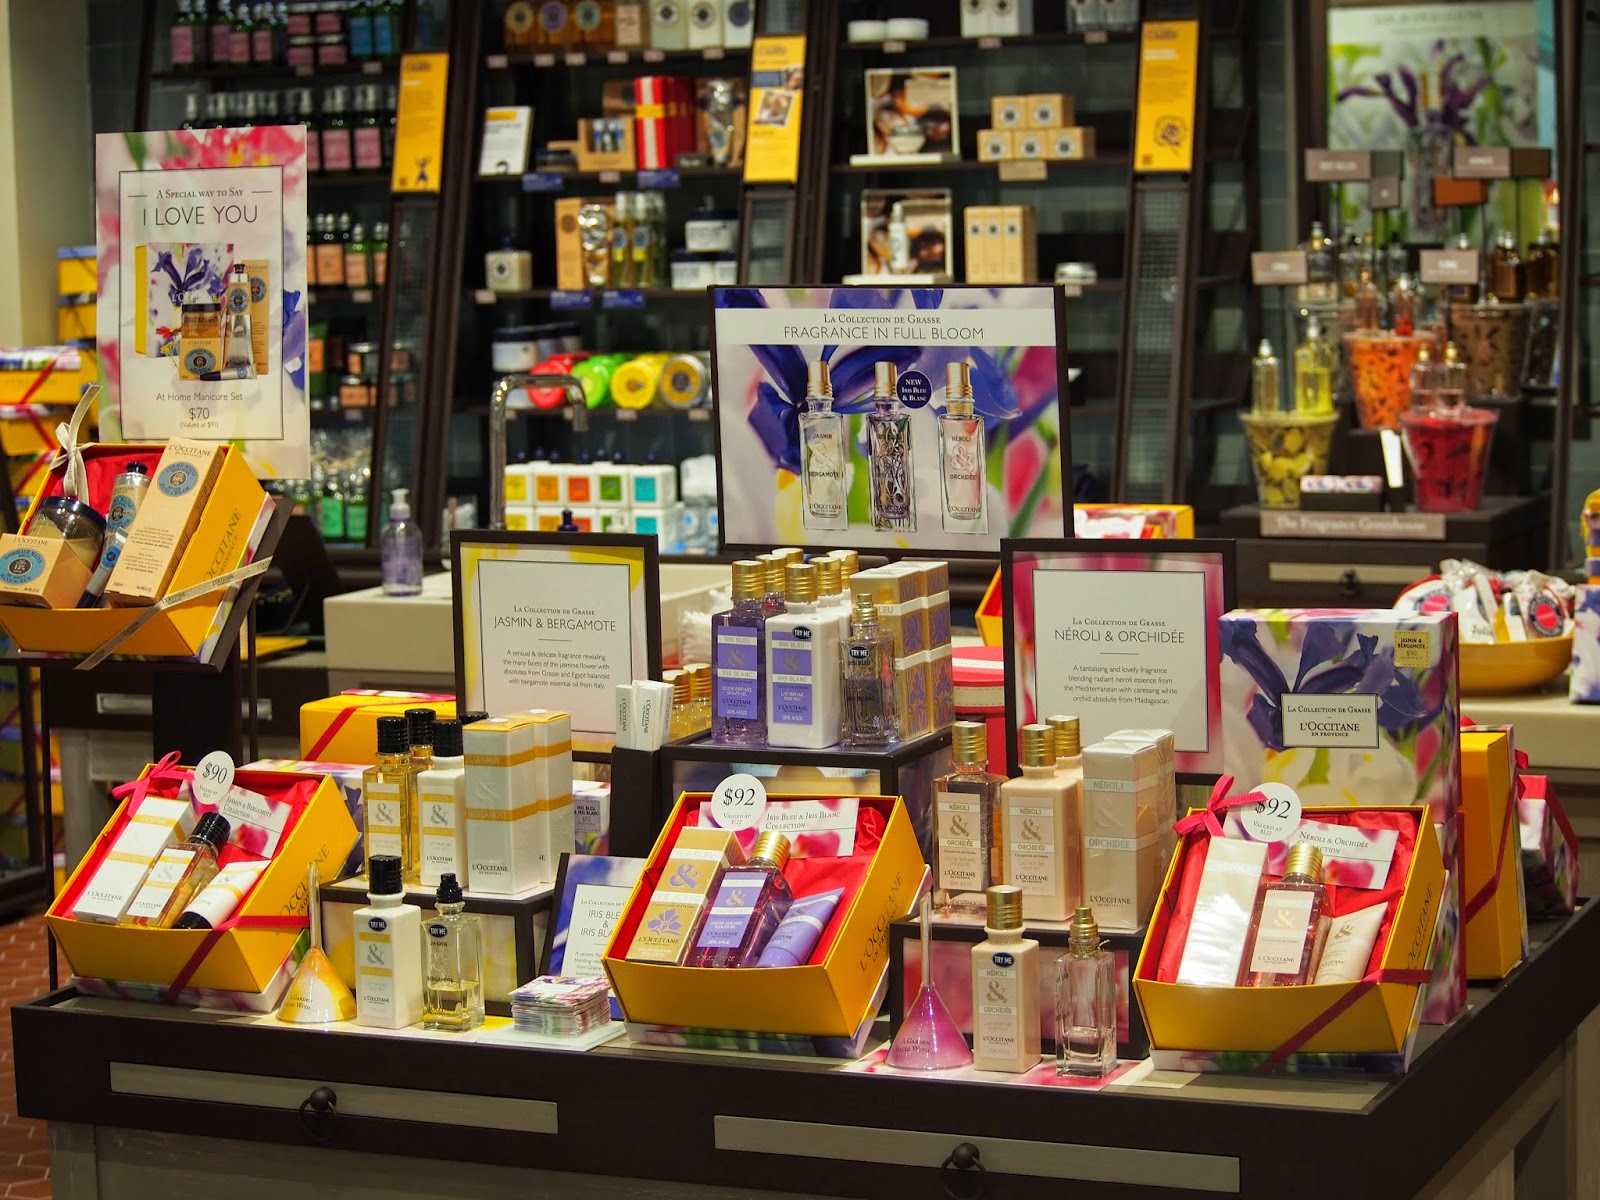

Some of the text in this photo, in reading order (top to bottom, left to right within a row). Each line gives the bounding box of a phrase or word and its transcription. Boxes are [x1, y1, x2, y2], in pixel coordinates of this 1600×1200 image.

[157, 190, 163, 199] A
[156, 206, 204, 226] LOVE
[213, 205, 258, 224] YOU
[784, 326, 984, 340] FRAGRANCE IN FULL BLOOM
[156, 392, 244, 401] At Home Manicure Set
[188, 407, 210, 421] $70
[169, 444, 212, 457] L'OCCITANE
[494, 616, 616, 631] JASMIN & BERGAMOTE
[1054, 627, 1185, 643] NÉROLI & ORCHIDÉE
[1069, 675, 1092, 683] blending
[1300, 721, 1360, 731] L'OCCITANE
[203, 762, 228, 784] $90
[1093, 779, 1124, 790] NÉROLI
[723, 788, 756, 806] $92
[1255, 798, 1291, 819] $92
[1089, 838, 1130, 848] ORCHIDÉE
[472, 864, 508, 872] L'OCCITANE
[1090, 896, 1131, 904] L'OCCITANE
[589, 910, 620, 920] IRIS BLE
[602, 920, 608, 928] &
[581, 928, 613, 938] IRIS BLA
